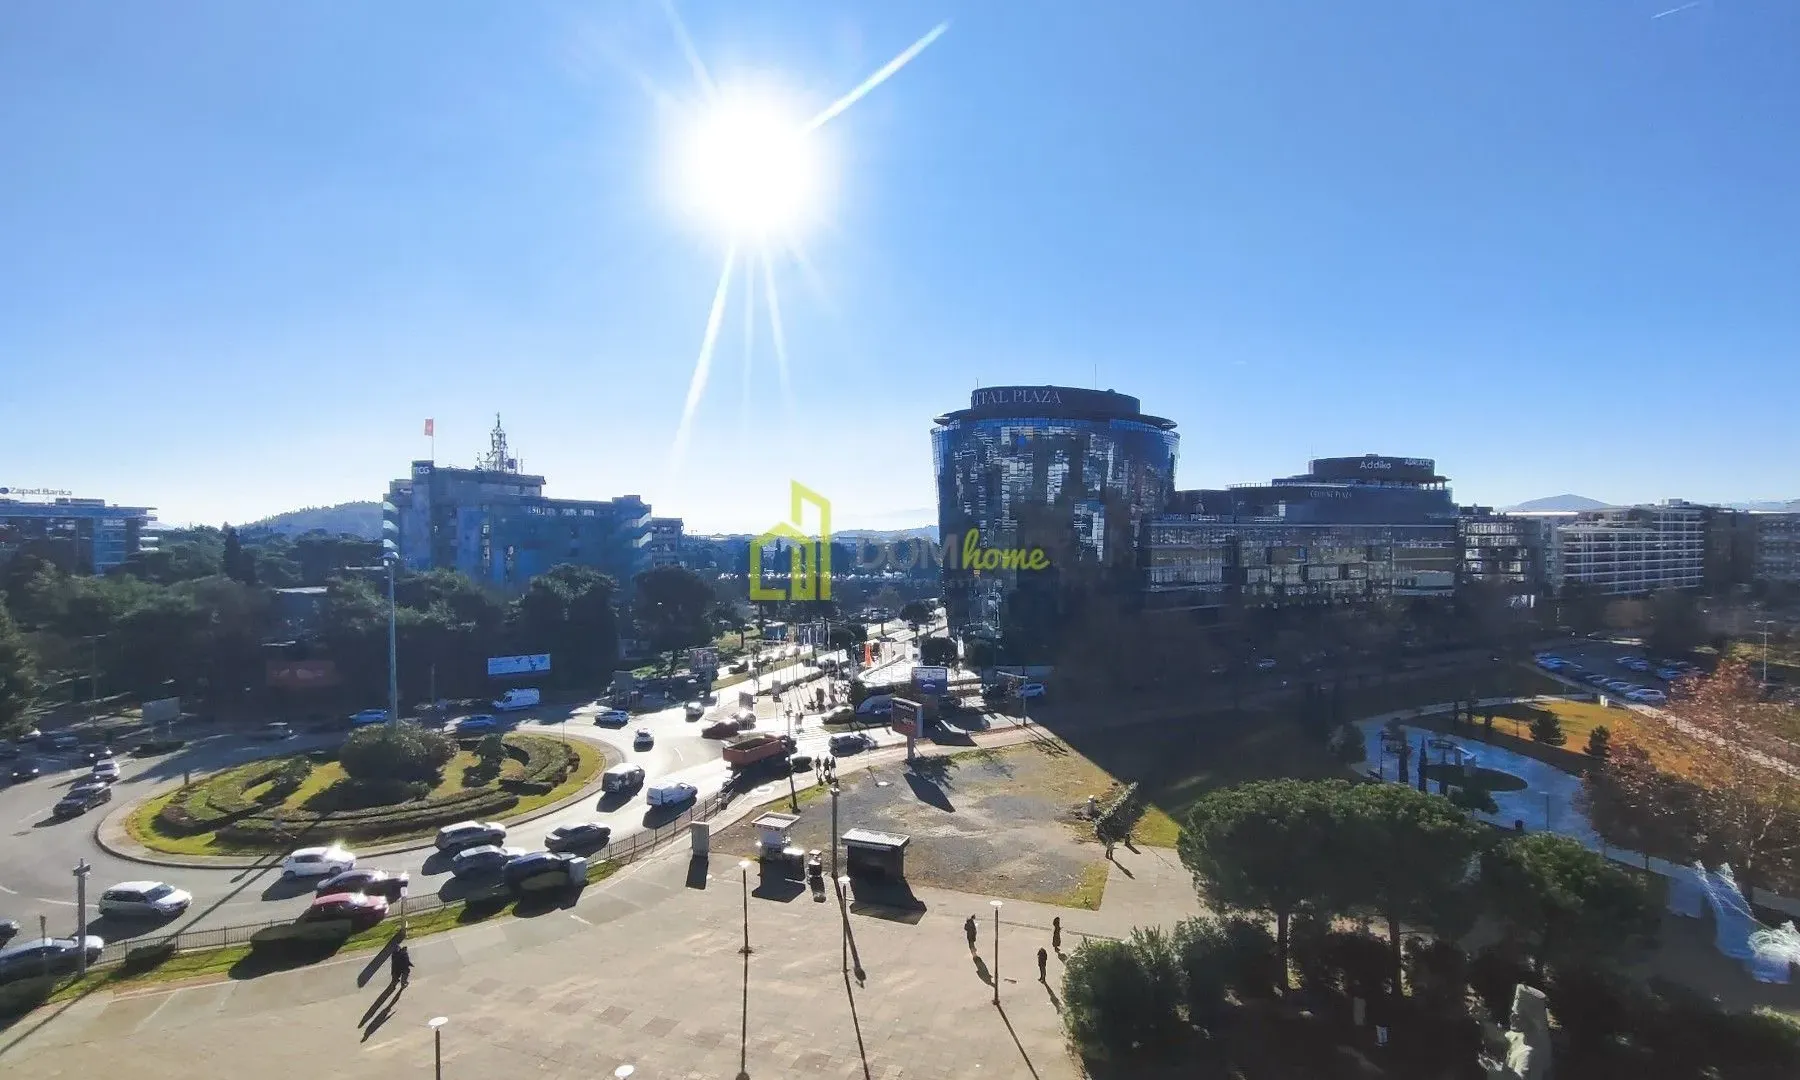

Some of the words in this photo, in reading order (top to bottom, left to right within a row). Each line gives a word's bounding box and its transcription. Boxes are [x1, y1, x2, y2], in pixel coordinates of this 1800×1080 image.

[973, 390, 1009, 405] ITAL
[1014, 389, 1062, 404] PLAZA
[1360, 460, 1392, 469] Addiko
[10, 487, 41, 496] Zapad
